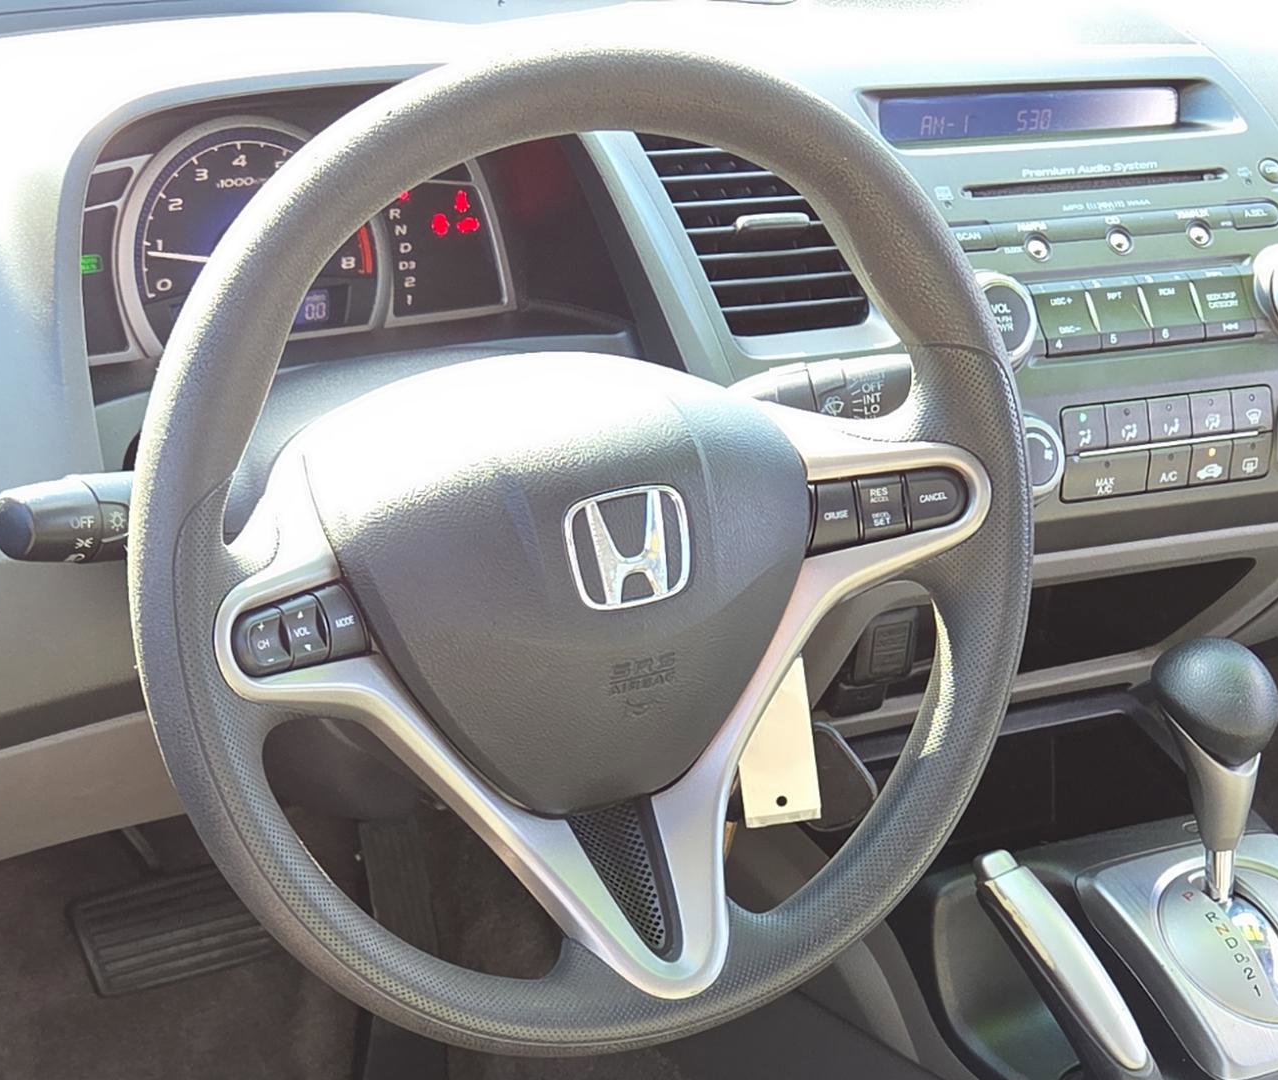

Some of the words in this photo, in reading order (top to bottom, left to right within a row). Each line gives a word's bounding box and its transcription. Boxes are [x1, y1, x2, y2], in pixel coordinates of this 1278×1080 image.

[920, 115, 970, 136] AM-1
[232, 154, 248, 167] 4
[195, 168, 209, 181] 3
[1022, 166, 1075, 178] Premium
[1077, 164, 1111, 174] Audio
[1113, 160, 1158, 173] System
[168, 198, 184, 211] 2
[389, 208, 401, 220] R
[394, 224, 408, 236] N
[156, 239, 164, 251] 1
[399, 242, 413, 254] D
[341, 256, 356, 270] 8
[156, 278, 172, 292] 0
[404, 276, 416, 288] 2
[406, 294, 413, 306] 1
[991, 303, 1011, 314] VOL
[1109, 333, 1117, 344] 5
[1161, 328, 1170, 339] 6
[1055, 338, 1063, 350] 4
[861, 381, 884, 393] OFF
[863, 392, 882, 405] INT
[864, 404, 880, 415] LO
[869, 486, 888, 497] RES
[919, 492, 948, 504] CANCEL
[70, 515, 95, 529] OFF
[873, 517, 891, 527] SET
[294, 626, 311, 638] VOL
[257, 639, 270, 650] CH
[1205, 911, 1220, 923] R
[1215, 923, 1230, 936] N
[1224, 936, 1239, 949] D
[1243, 966, 1256, 980] 2
[1253, 984, 1261, 997] 1
